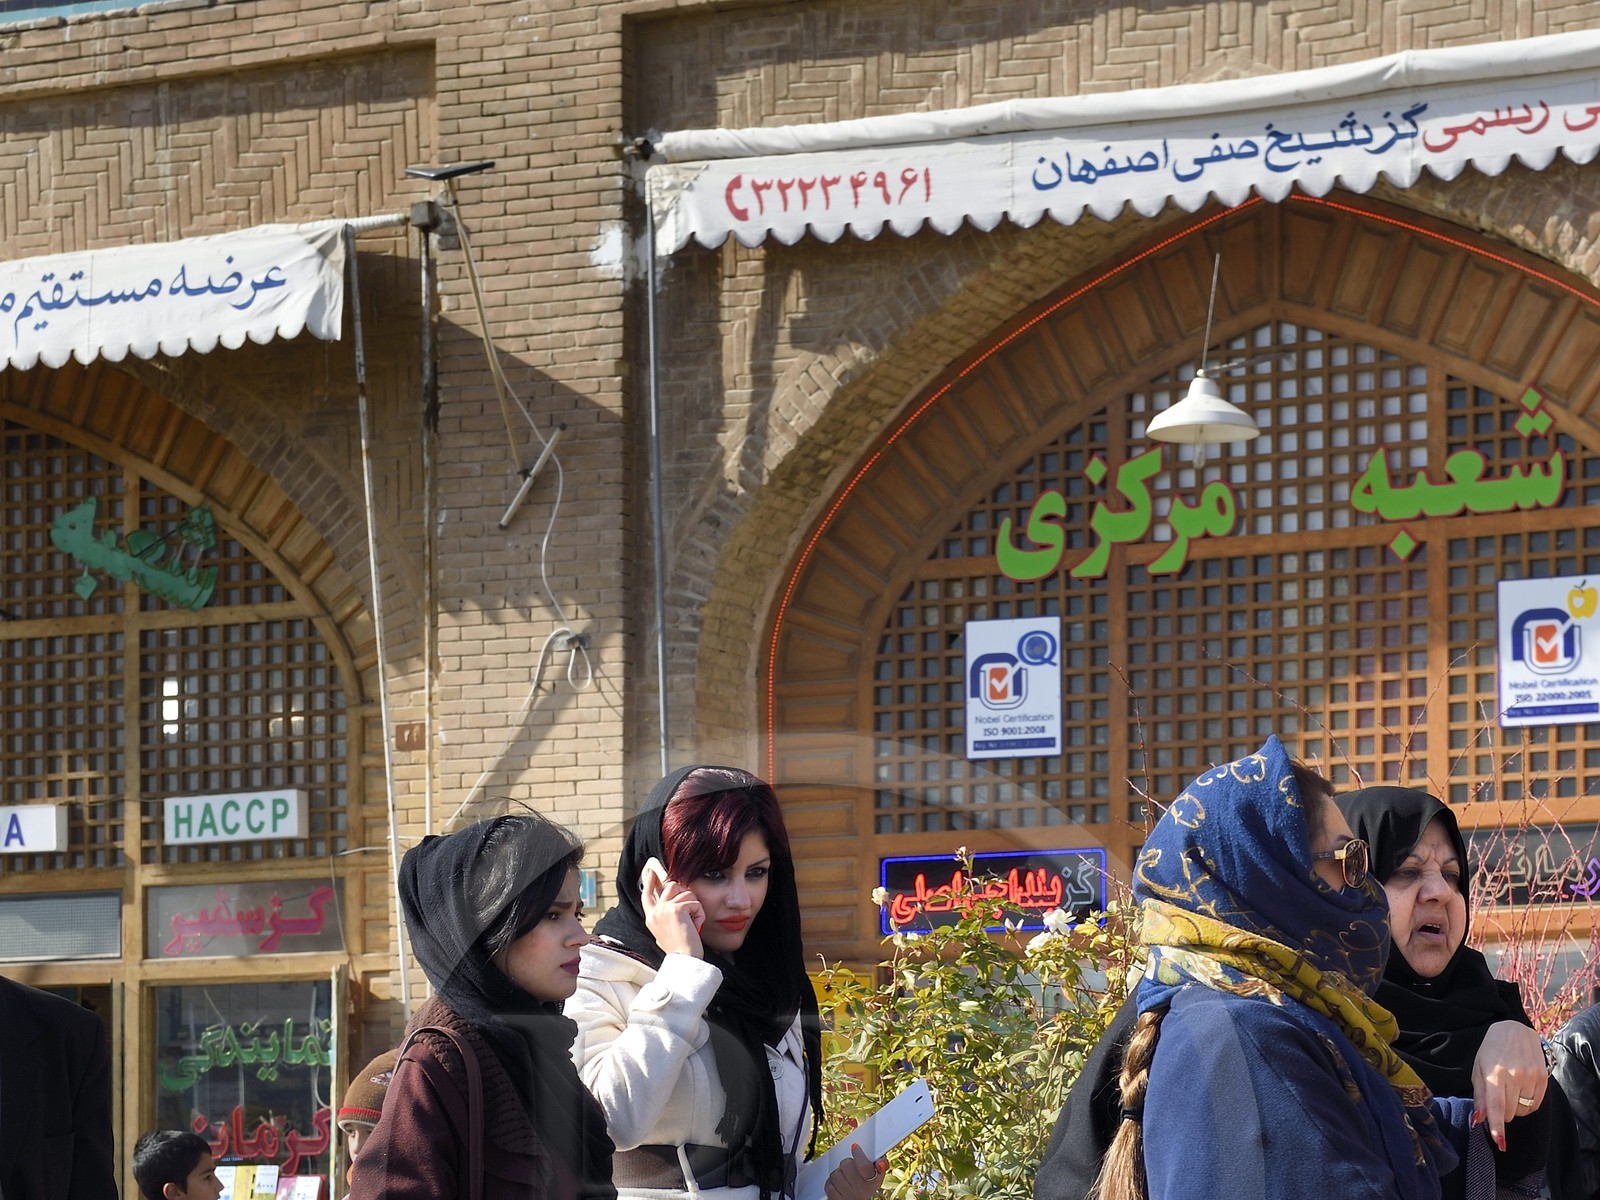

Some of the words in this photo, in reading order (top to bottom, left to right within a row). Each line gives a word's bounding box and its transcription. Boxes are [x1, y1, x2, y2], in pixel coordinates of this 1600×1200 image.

[1422, 99, 1550, 154] رسمی
[1031, 138, 1169, 192] اصفهان
[1172, 132, 1260, 182] صفی
[750, 167, 932, 216] ۳۲۲۳۴۹۶۱
[168, 256, 287, 310] عرضه
[15, 271, 163, 350] مستقیم
[1350, 384, 1567, 561] شعبه
[995, 443, 1236, 582] مرکزی
[974, 715, 1001, 725] Nobel
[1003, 713, 1055, 723] Certification
[983, 727, 999, 737] ISO
[174, 798, 290, 839] HACCP
